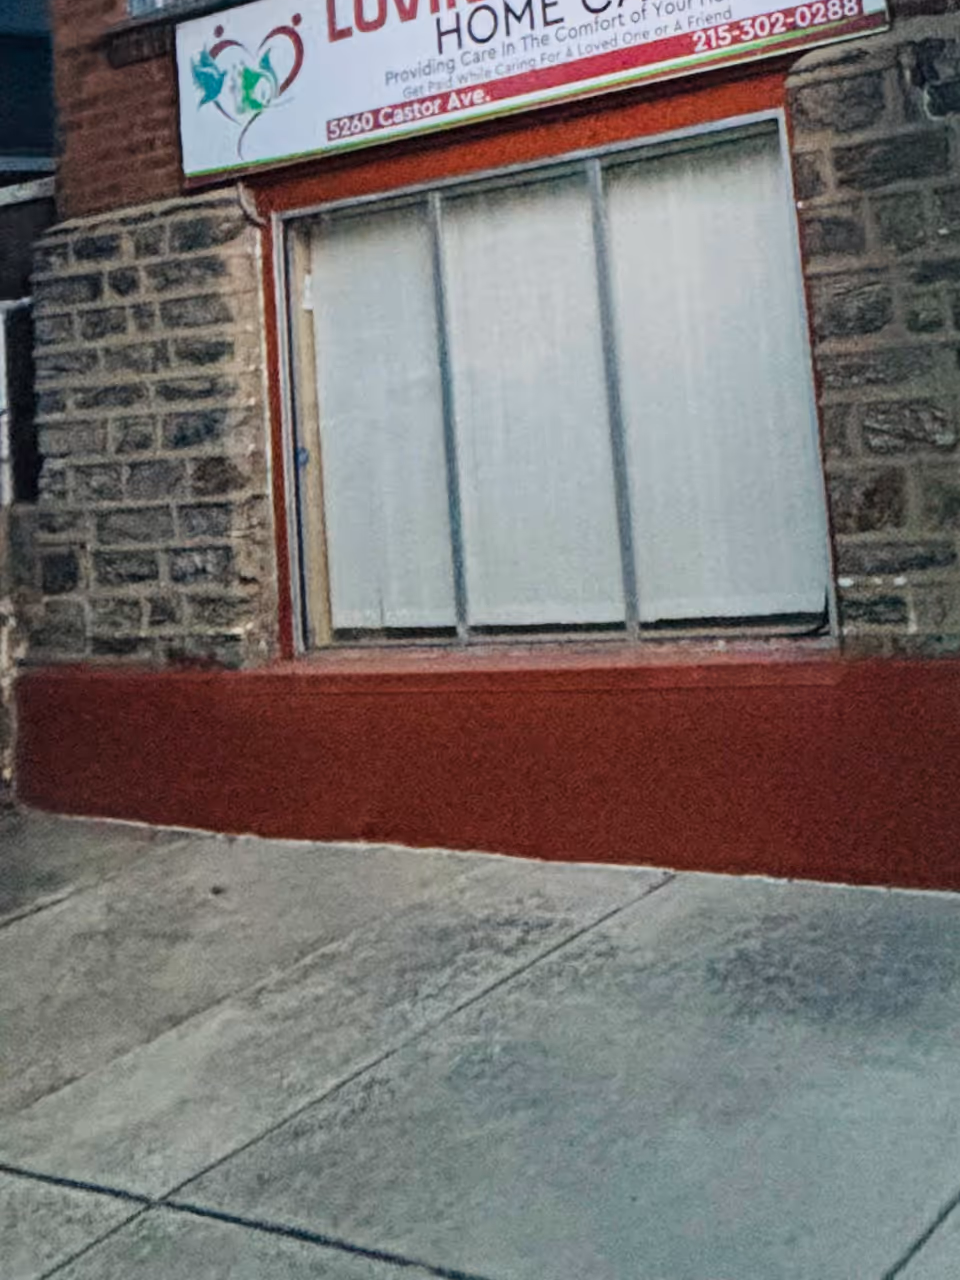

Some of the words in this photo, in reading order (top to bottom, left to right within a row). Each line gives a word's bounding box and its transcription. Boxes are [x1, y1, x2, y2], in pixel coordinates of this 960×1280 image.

[385, 57, 456, 87] Providing
[460, 47, 496, 67] Care
[502, 40, 516, 58] In
[520, 32, 550, 53] The
[555, 11, 625, 43] Comfort
[632, 3, 651, 25] of
[402, 83, 425, 100] Get
[495, 57, 536, 78] Caring
[540, 49, 561, 65] For
[565, 46, 574, 58] A
[577, 35, 618, 57] Loved
[622, 29, 650, 45] One
[654, 24, 669, 38] or
[673, 20, 683, 32] A
[686, 6, 733, 28] Friend
[328, 112, 374, 141] 5260
[376, 96, 442, 131] Castor
[446, 86, 491, 115] Ave.
